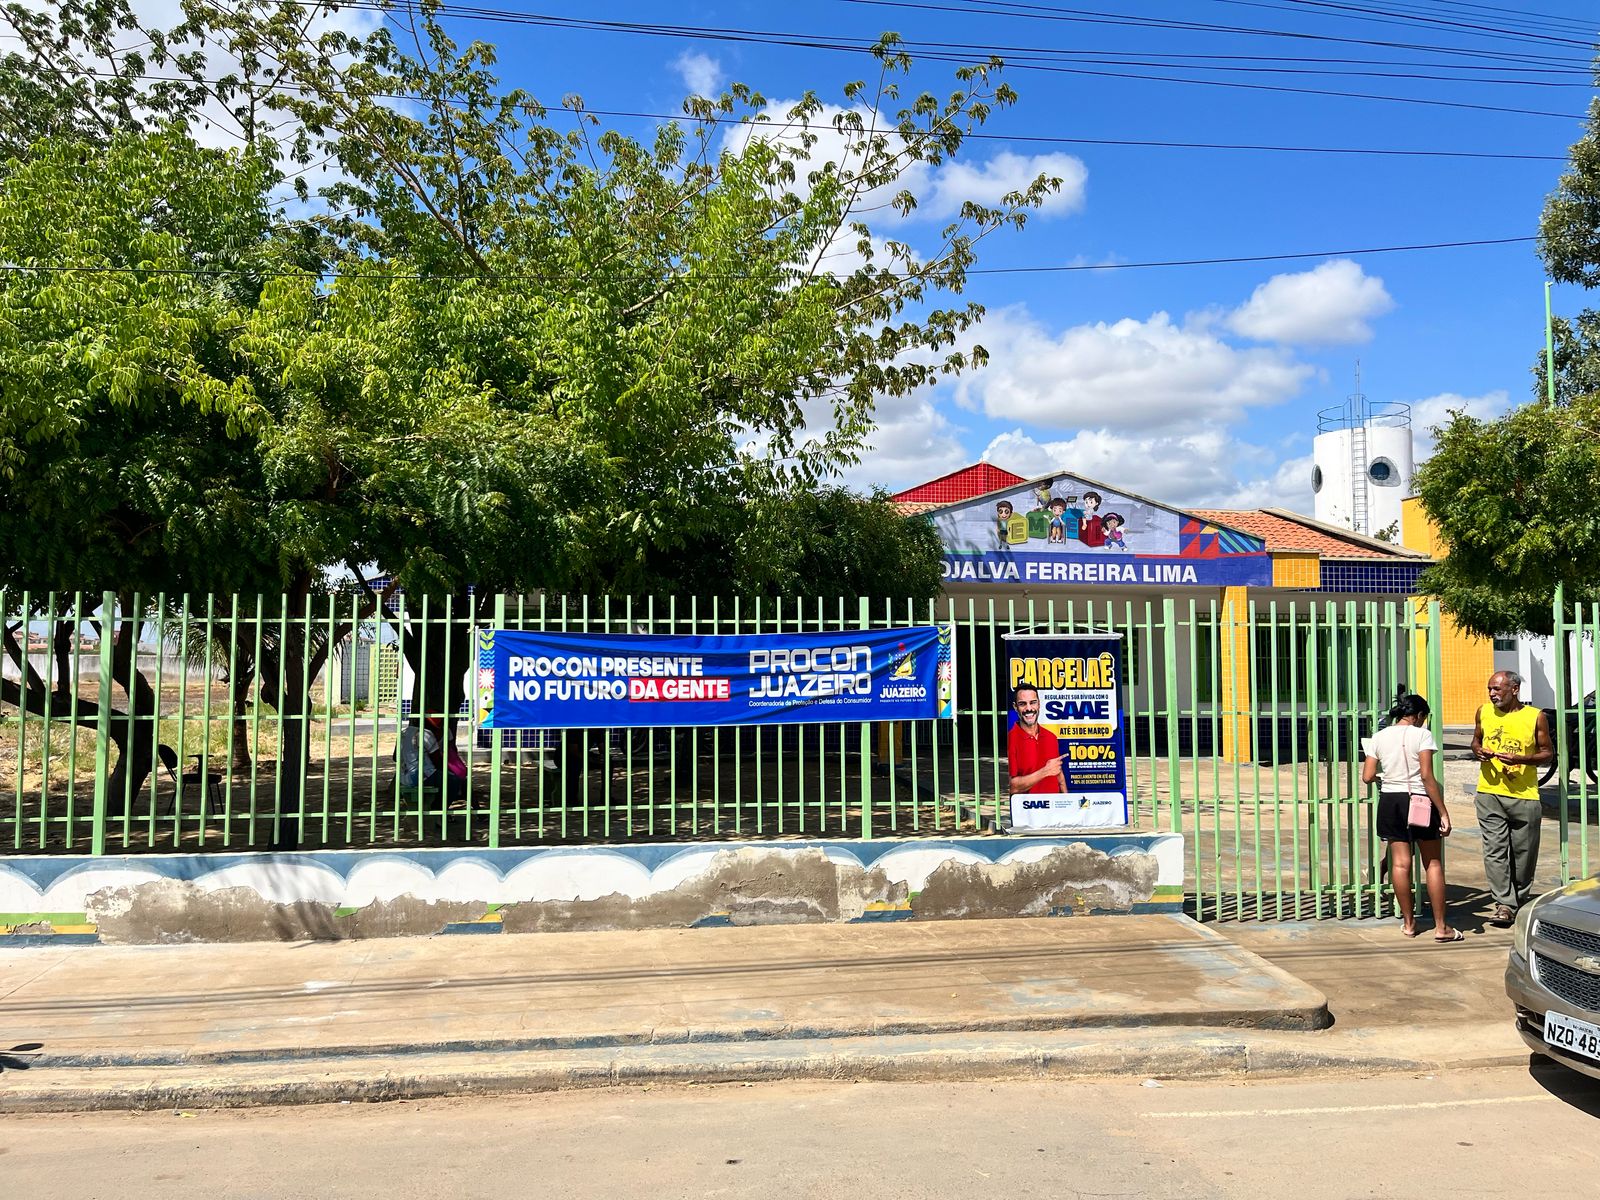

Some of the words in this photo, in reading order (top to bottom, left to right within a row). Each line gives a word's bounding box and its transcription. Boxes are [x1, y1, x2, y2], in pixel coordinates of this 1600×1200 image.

[1025, 562, 1137, 581] FERREIRA
[1142, 565, 1198, 583] LIMA
[509, 656, 598, 677] PROCON
[601, 657, 703, 677] PRESENTE
[750, 645, 872, 674] PROCON
[1010, 652, 1114, 690] PARCELAÊ
[508, 680, 541, 701] NO
[544, 680, 627, 701] FUTURO
[630, 679, 659, 699] DA
[662, 679, 729, 699] GENTE
[749, 673, 872, 698] JUAZEIRO
[879, 687, 927, 698] JUAZEIRO
[792, 699, 814, 707] Proteção
[843, 696, 872, 705] Consumidor
[1045, 700, 1110, 720] SAAE
[1060, 725, 1071, 735] ATÉ
[1072, 727, 1079, 735] 31
[1079, 727, 1087, 735] DE
[1087, 727, 1110, 736] MARÇO
[1069, 745, 1116, 760] 100%
[1022, 800, 1050, 809] SAAE
